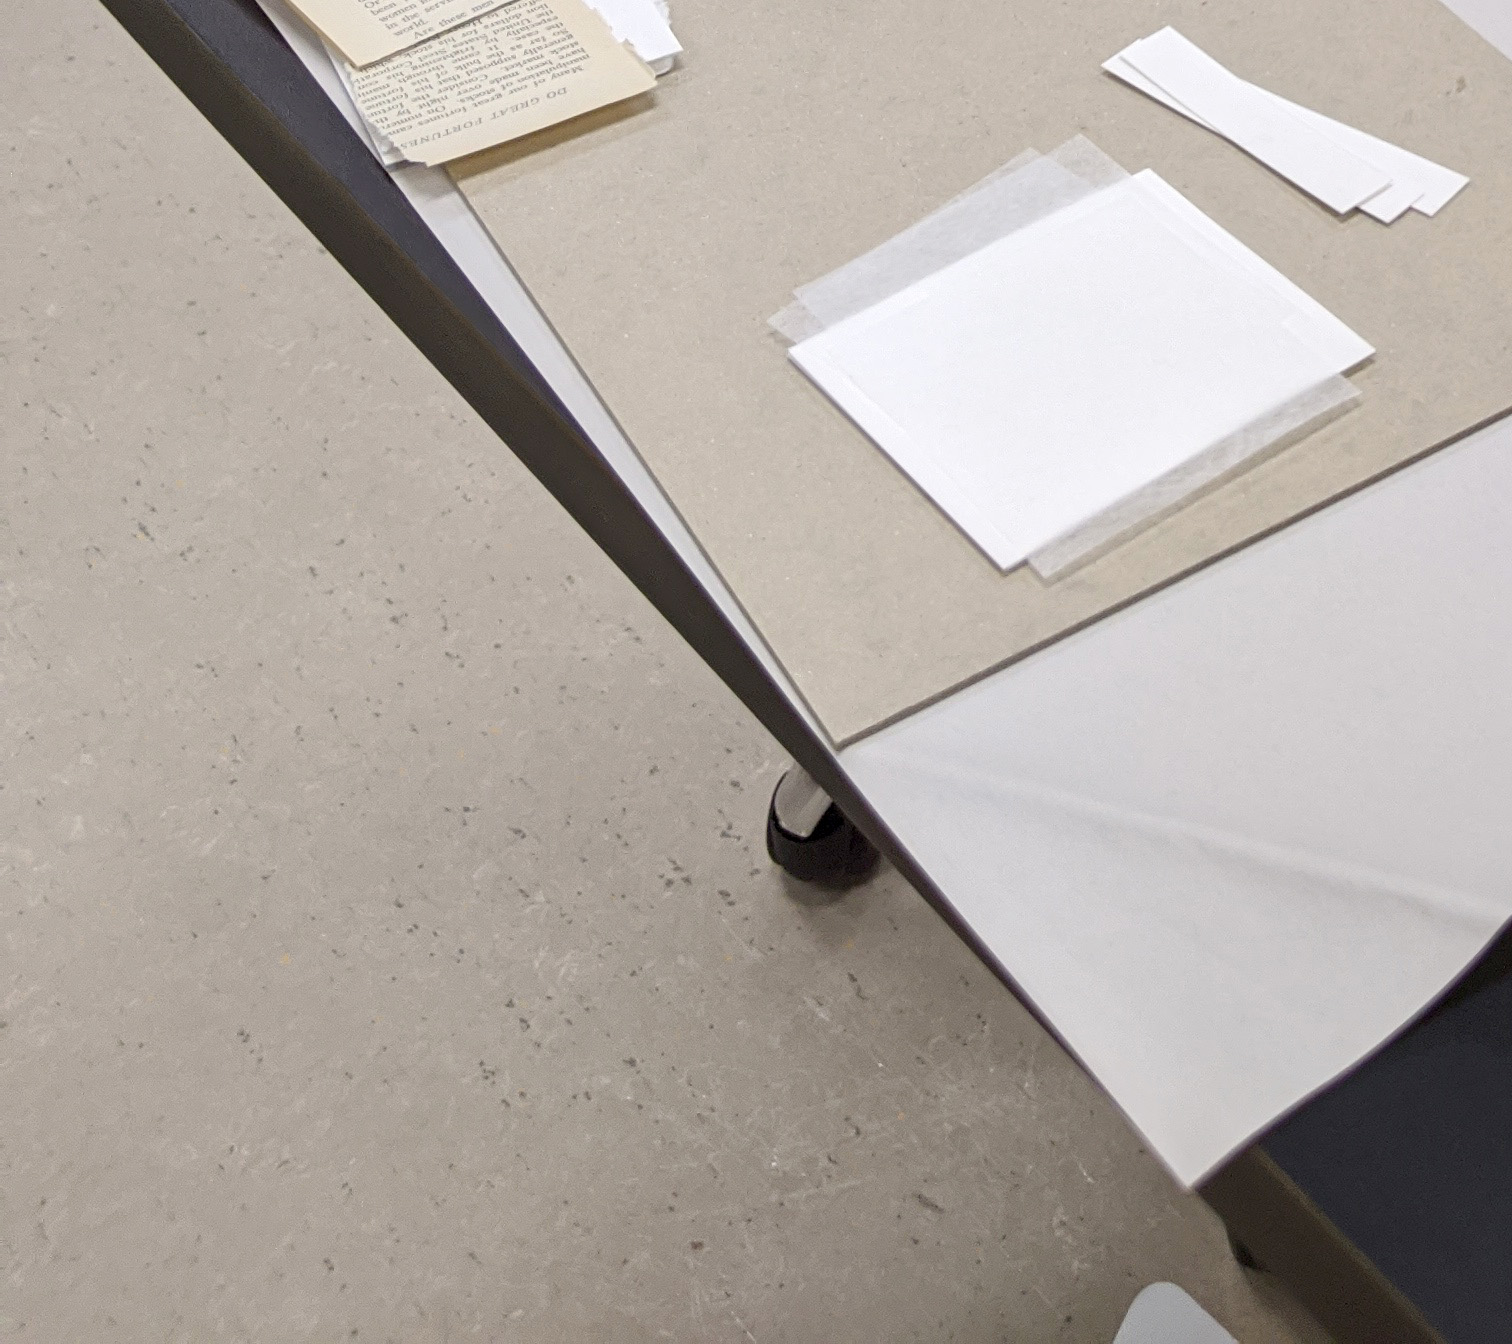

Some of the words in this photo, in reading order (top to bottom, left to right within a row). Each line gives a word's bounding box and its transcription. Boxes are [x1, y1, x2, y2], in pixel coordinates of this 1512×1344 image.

[370, 2, 396, 15] been
[378, 3, 416, 22] women
[401, 12, 419, 22] the
[414, 26, 434, 39] Are
[438, 12, 466, 26] these
[471, 0, 494, 12] men
